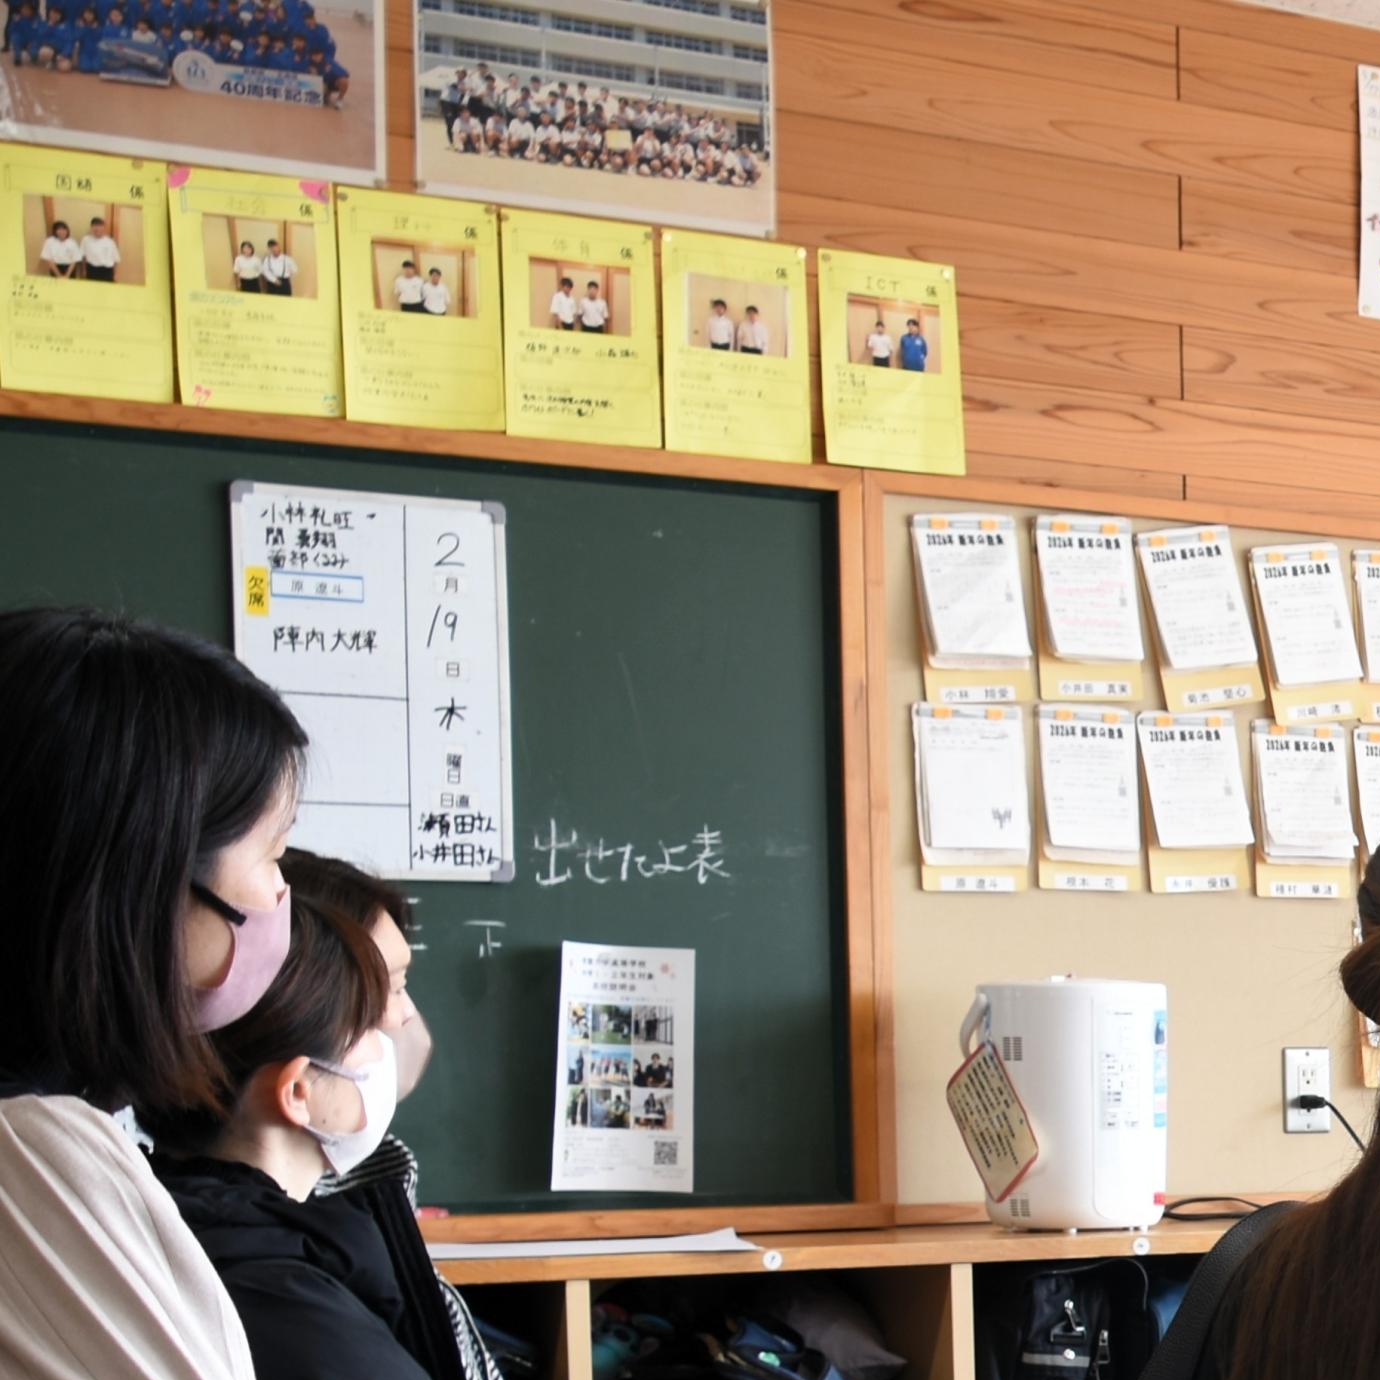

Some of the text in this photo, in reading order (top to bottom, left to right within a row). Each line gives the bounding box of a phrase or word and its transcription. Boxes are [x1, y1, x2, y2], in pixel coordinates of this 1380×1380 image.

[130, 185, 145, 200] 係
[299, 203, 314, 218] 係
[465, 224, 478, 240] 係
[620, 245, 634, 262] 係
[774, 266, 788, 281] 係
[864, 275, 939, 300] ICT 係
[434, 532, 466, 568] 2
[248, 575, 265, 608] 欠席
[444, 576, 459, 594] 月
[426, 604, 459, 649] 19
[446, 660, 460, 678] 日
[434, 697, 468, 731] 木
[446, 753, 462, 785] 曜日
[440, 792, 470, 809] 日直
[412, 841, 502, 868] 小井田さん
[533, 817, 732, 887] 出せたよ表
